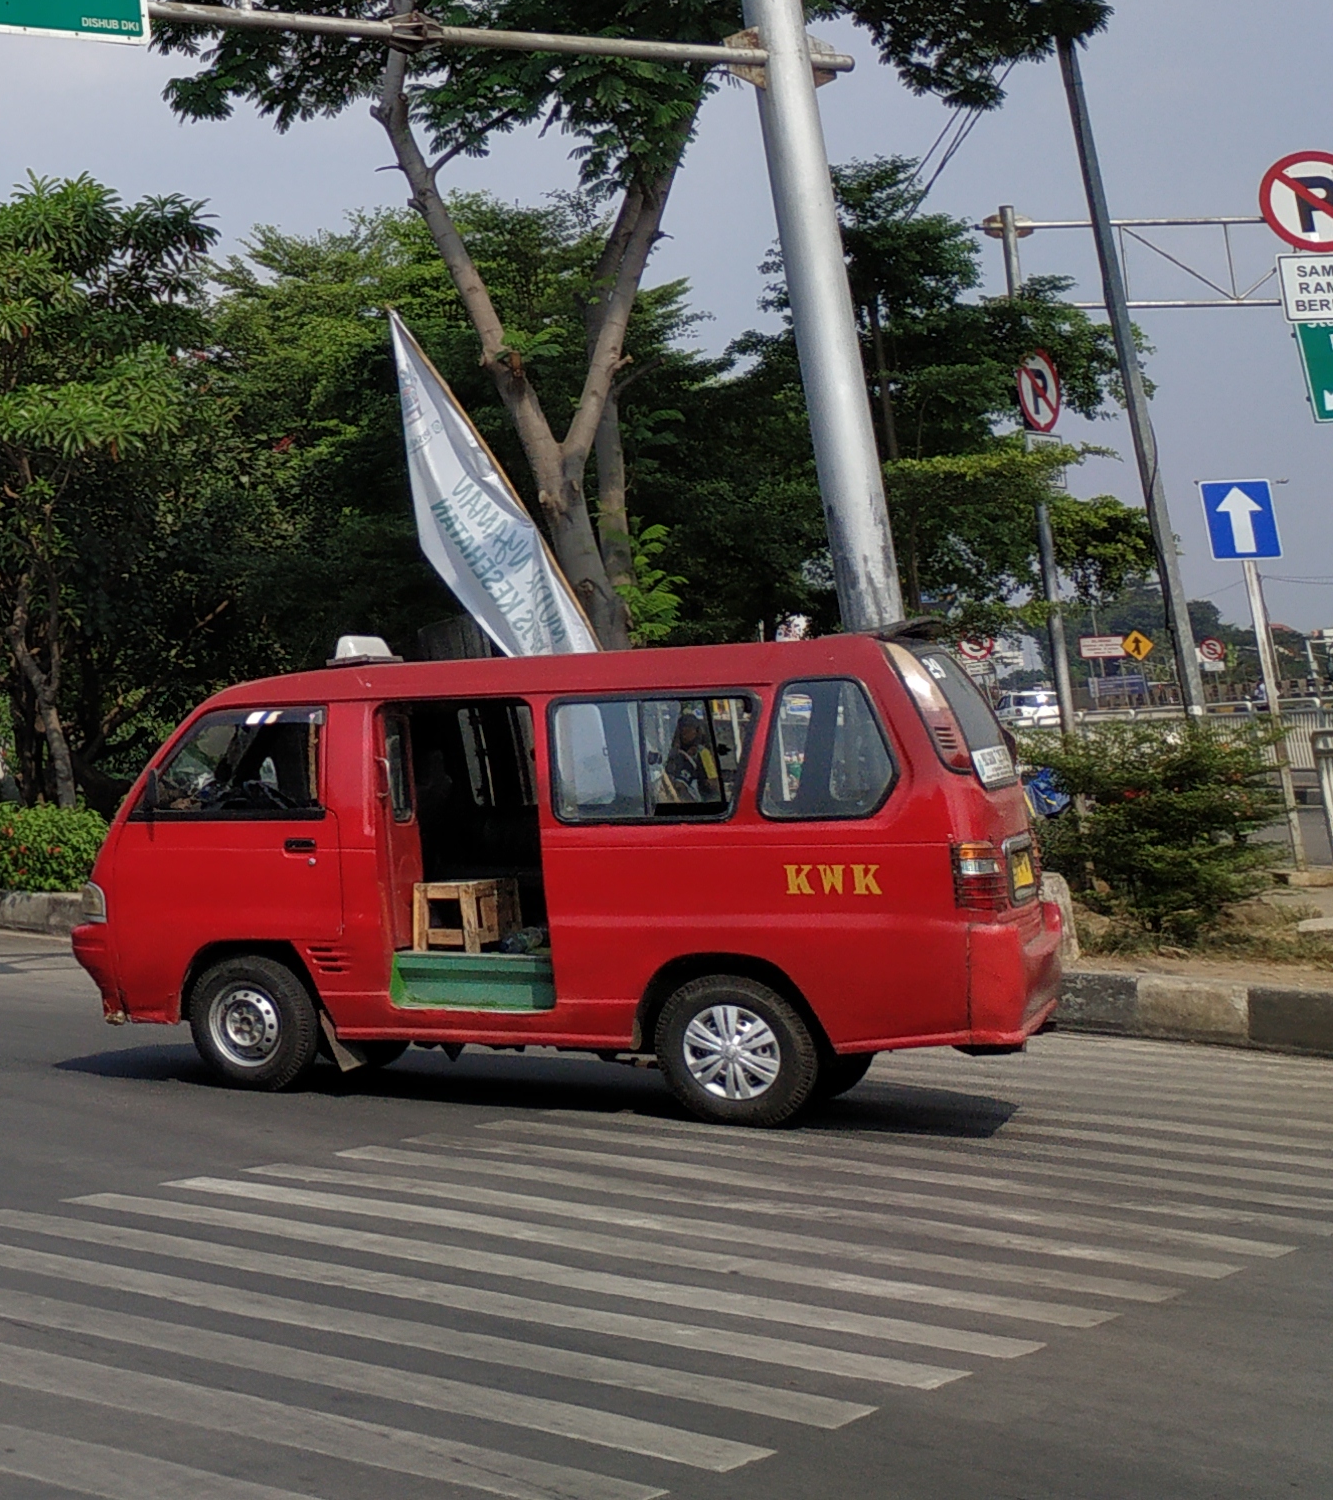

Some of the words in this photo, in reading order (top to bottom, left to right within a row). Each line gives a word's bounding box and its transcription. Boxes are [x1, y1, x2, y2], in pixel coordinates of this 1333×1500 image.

[80, 15, 119, 32] DISHUB
[120, 18, 140, 33] DKI
[783, 864, 883, 896] KWK
